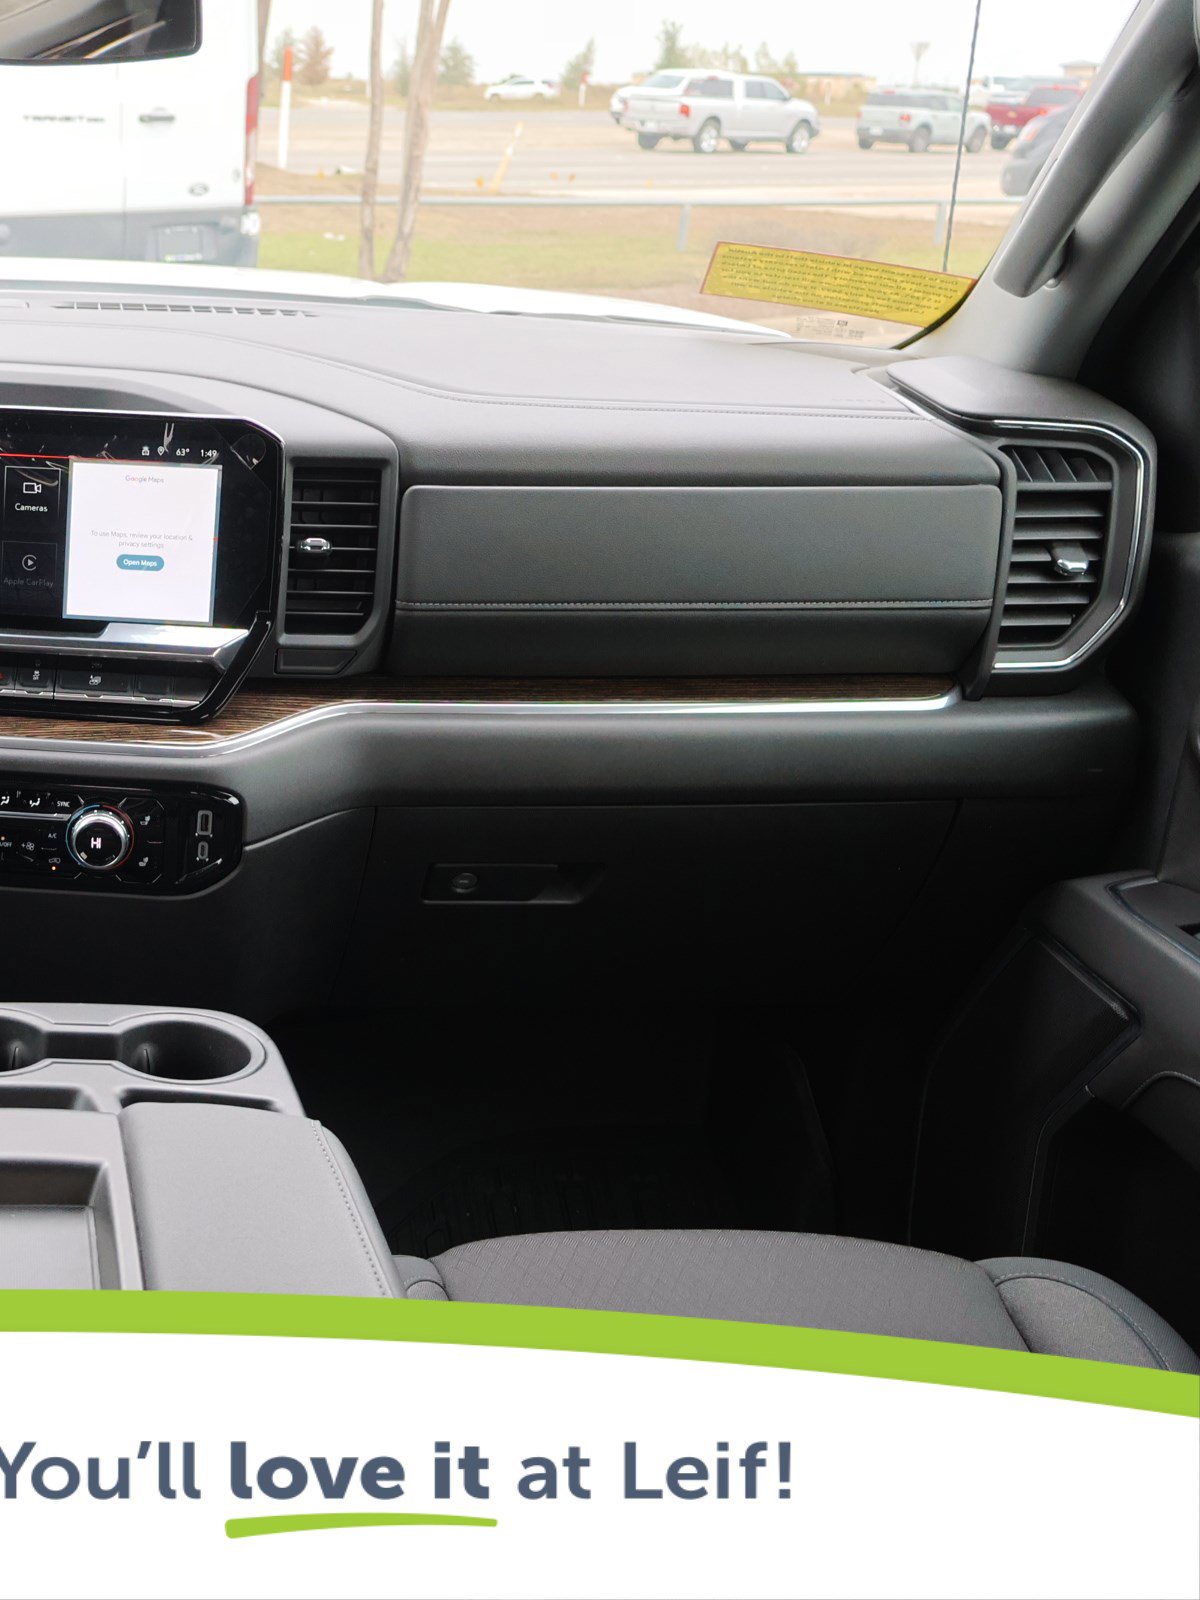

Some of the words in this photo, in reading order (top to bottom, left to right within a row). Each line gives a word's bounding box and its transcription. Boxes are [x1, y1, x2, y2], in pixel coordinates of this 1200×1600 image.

[200, 449, 217, 457] 1:49
[125, 475, 147, 484] Google
[148, 476, 164, 485] Maps
[14, 503, 48, 512] Cameras
[130, 532, 148, 540] review
[149, 533, 162, 541] your
[163, 533, 186, 541] location
[118, 540, 139, 549] privacy
[141, 541, 164, 549] settings
[123, 559, 140, 567] Open
[141, 559, 157, 568] Maps
[4, 577, 24, 586] Apple
[26, 578, 53, 588] CarPlay
[90, 837, 102, 849] HI
